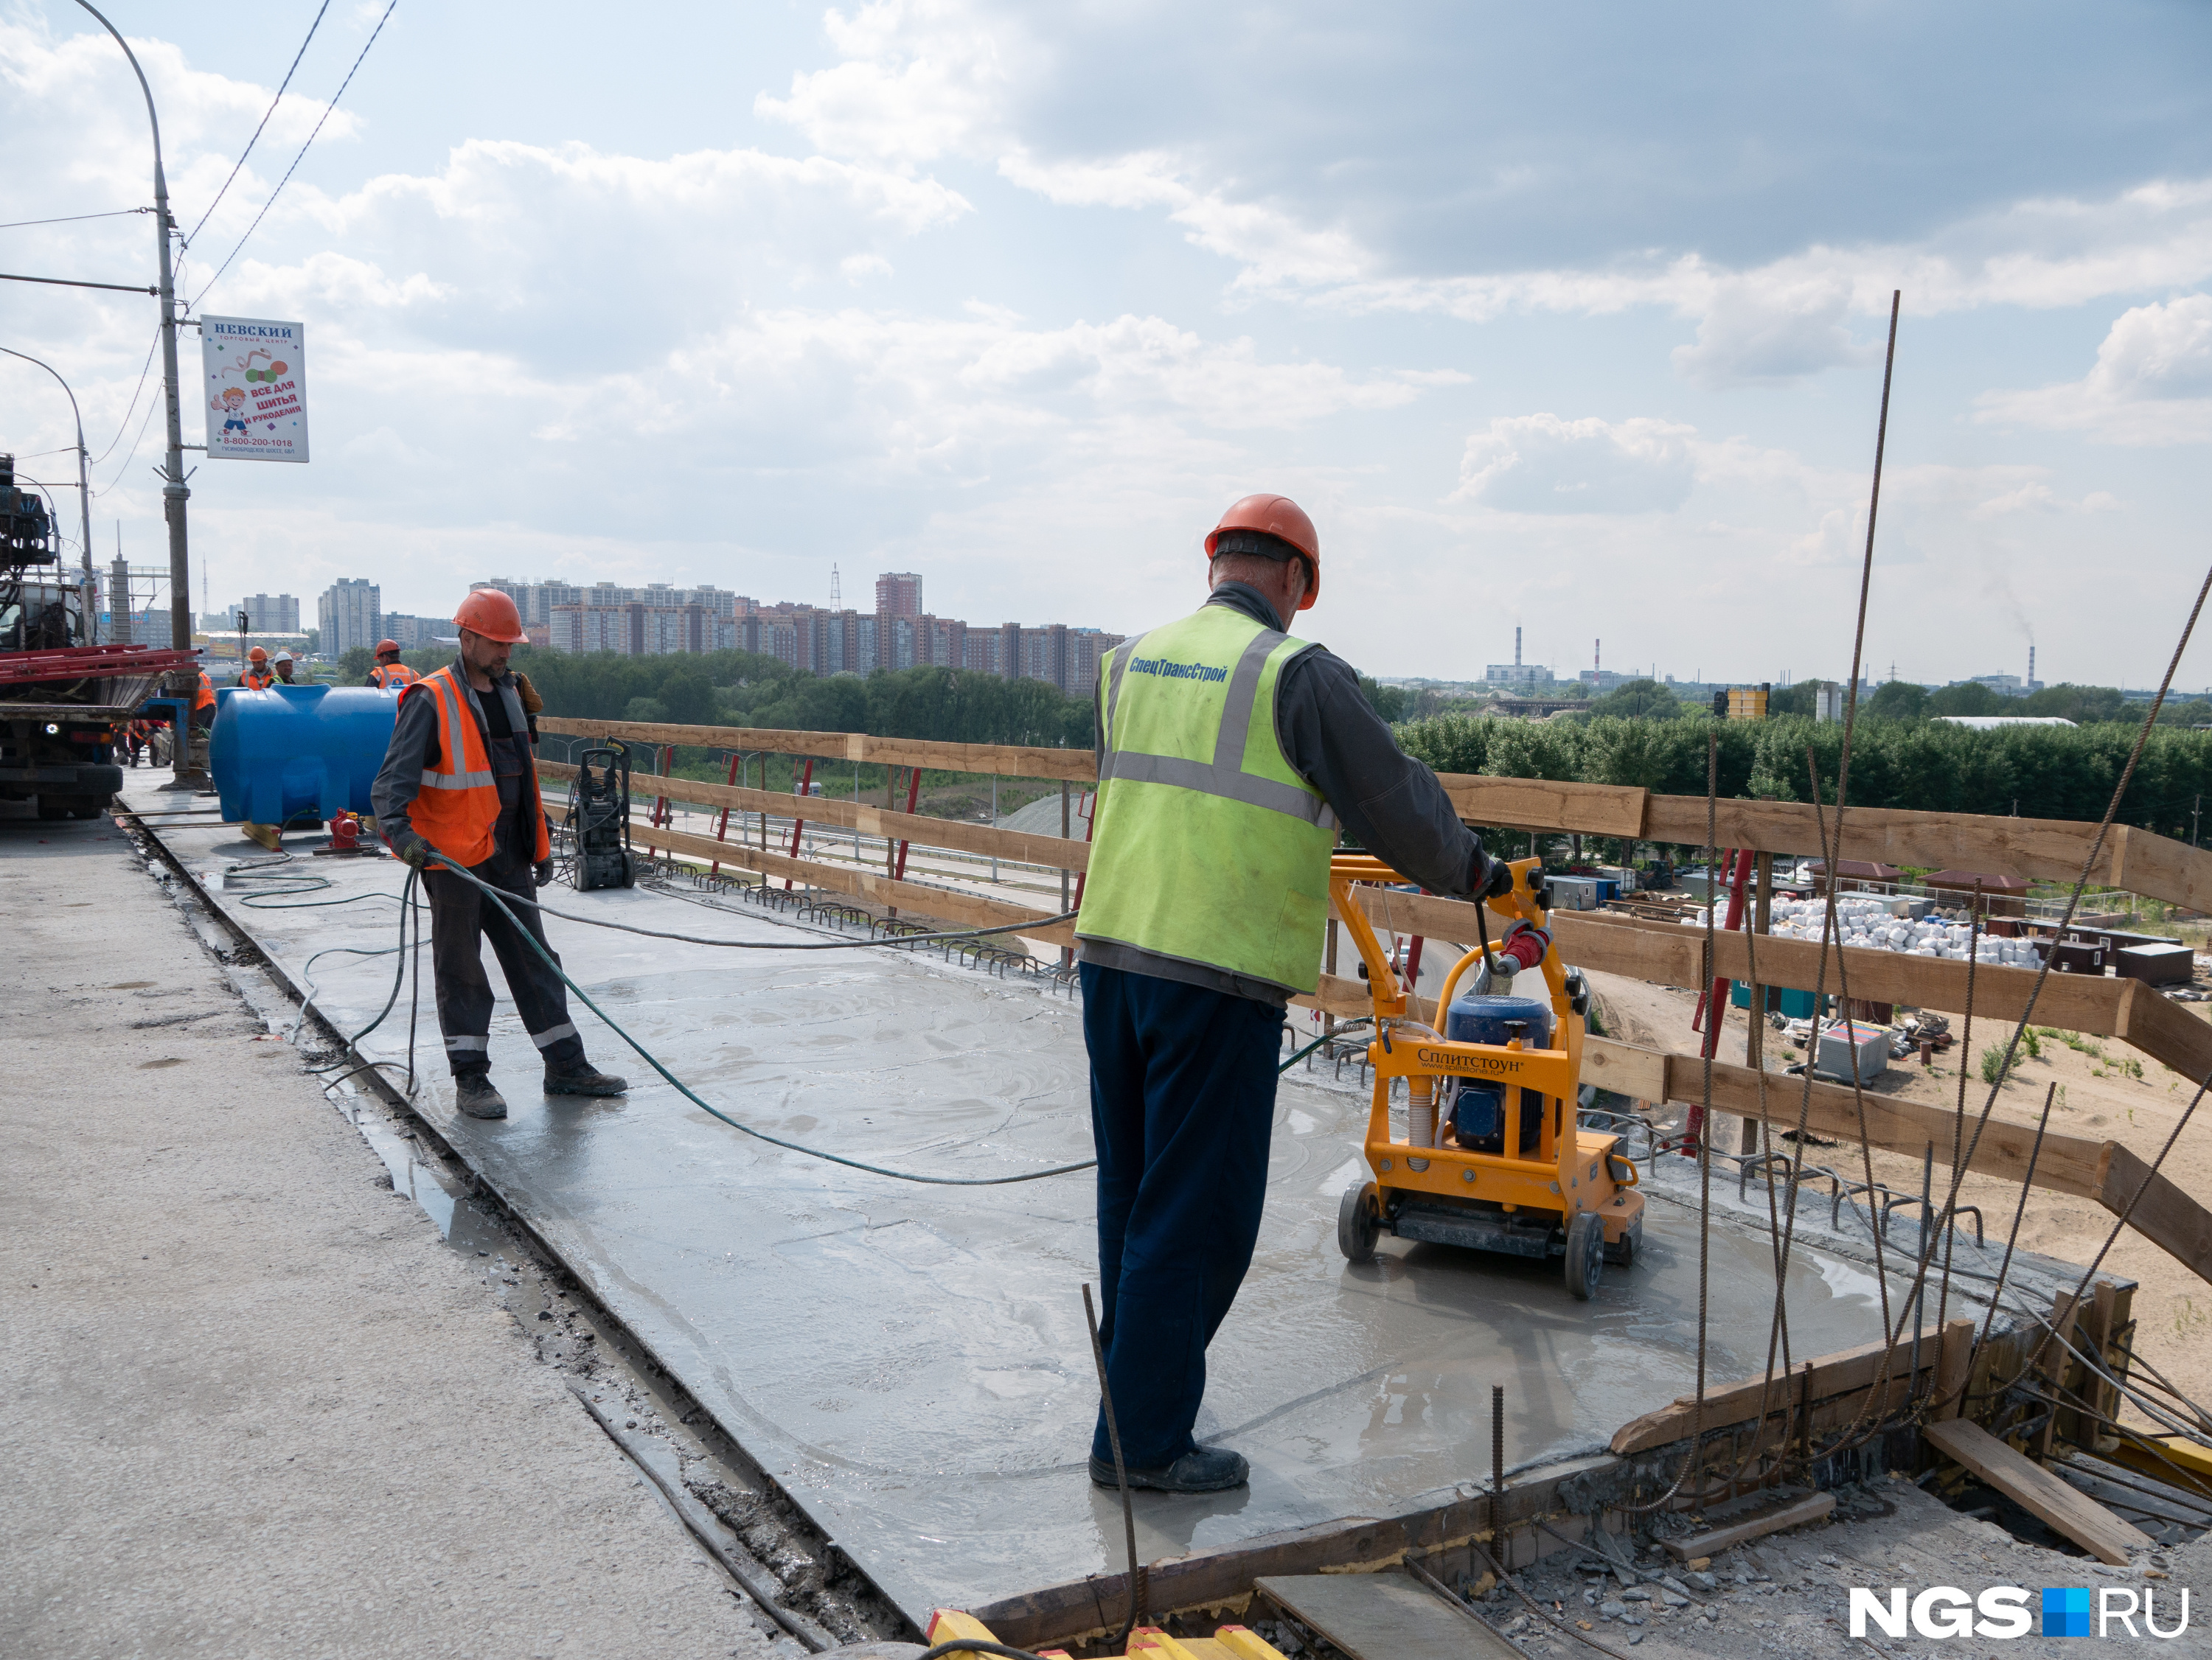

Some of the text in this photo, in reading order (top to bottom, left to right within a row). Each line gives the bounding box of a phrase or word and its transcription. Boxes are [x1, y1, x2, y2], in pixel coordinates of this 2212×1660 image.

[214, 323, 292, 338] НЕВСКИЙ
[250, 380, 295, 398] ВСЕ ДЛЯ
[256, 394, 298, 411] ШИТЬЯ
[252, 405, 302, 422] РУКОДЕЛИЯ
[223, 437, 293, 447] 8-800-200-1018
[1130, 657, 1228, 683] СпецТрансСтрой
[1421, 1061, 1500, 1075] www.splitstone.ru
